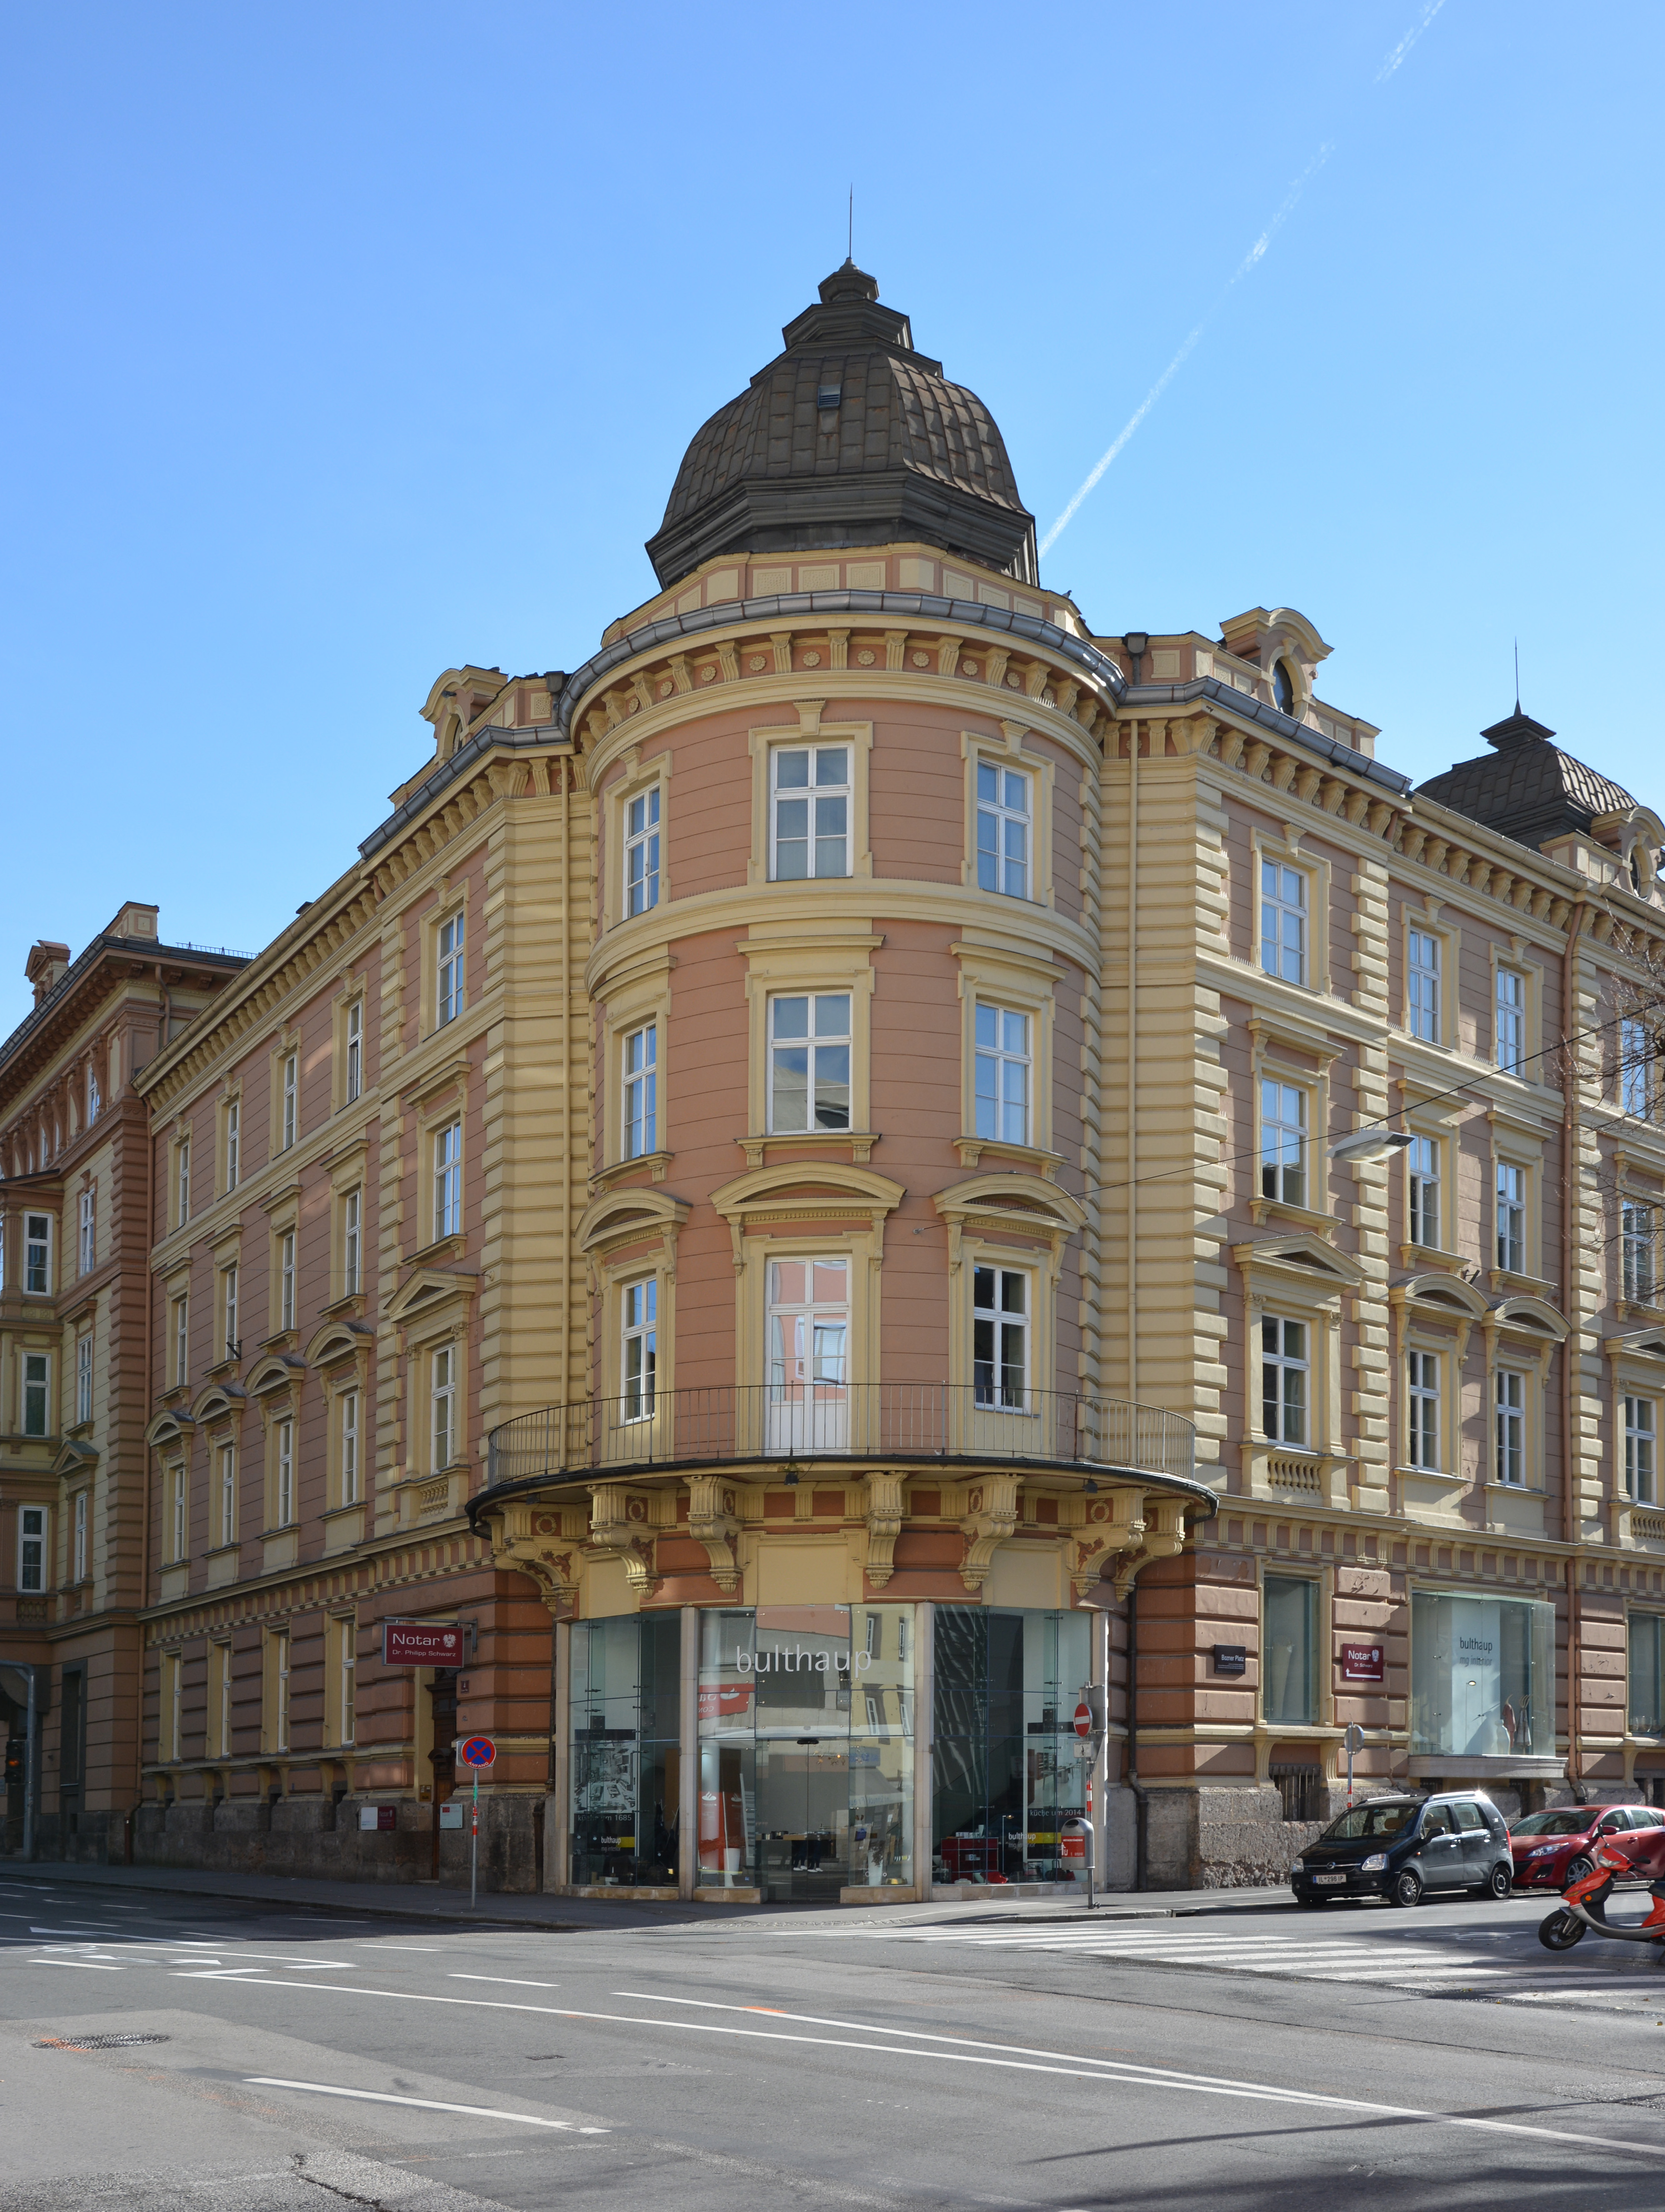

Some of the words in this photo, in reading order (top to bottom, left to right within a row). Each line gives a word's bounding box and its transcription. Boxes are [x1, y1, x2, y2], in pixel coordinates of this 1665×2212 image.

[392, 1633, 440, 1645] Notar
[1460, 1637, 1492, 1654] bulthaup
[1348, 1650, 1371, 1660] Notar
[737, 1644, 871, 1678] bulthaup
[1460, 1657, 1469, 1667] mg
[601, 1836, 621, 1845] bulthaup
[1008, 1832, 1036, 1841] bulthaup
